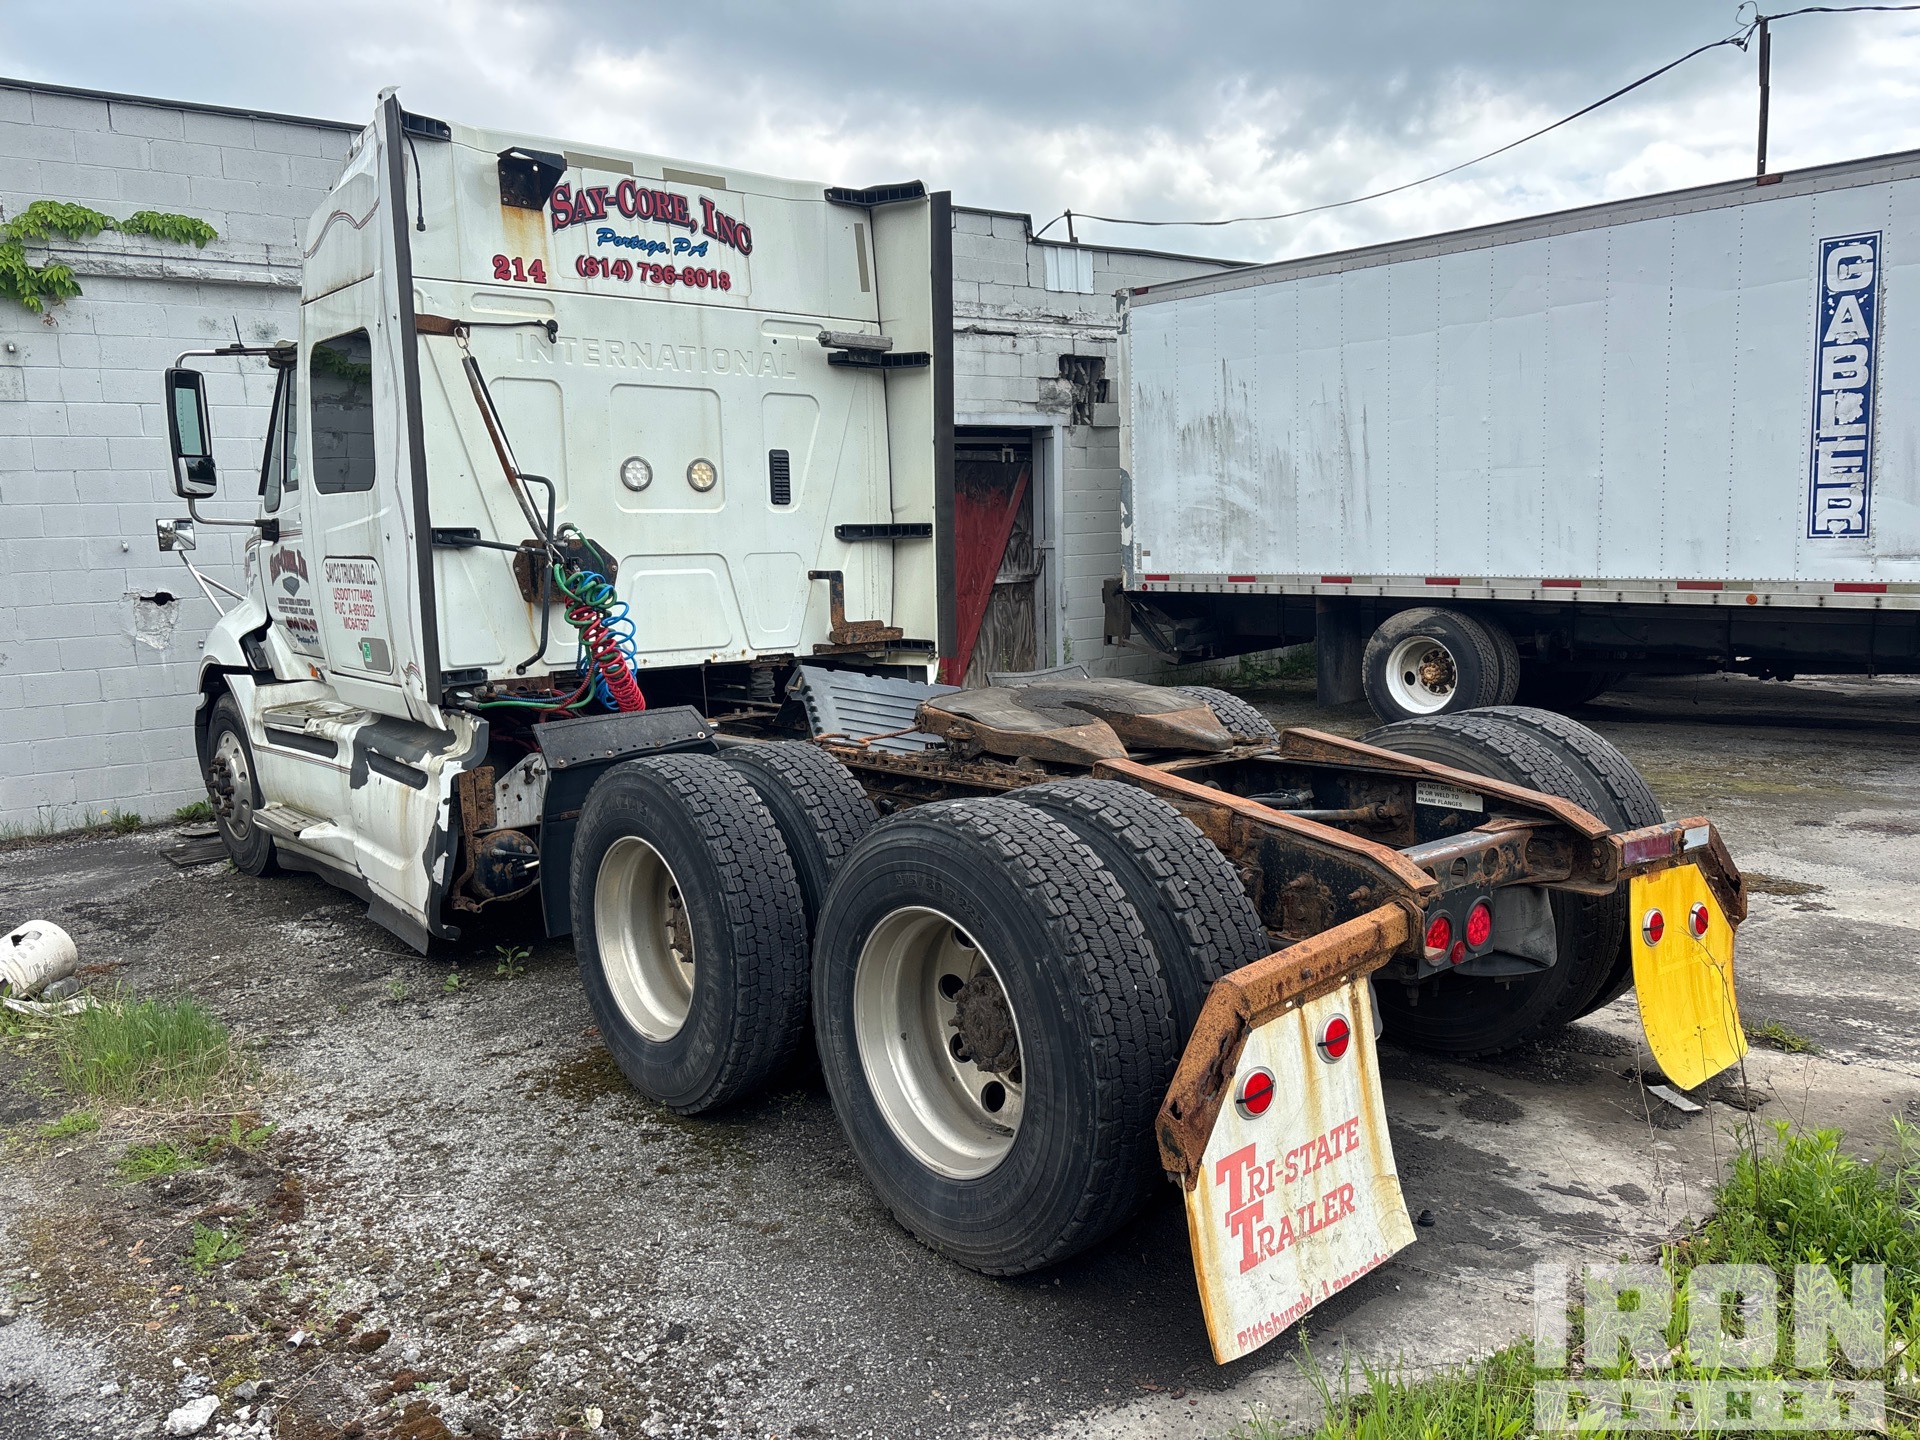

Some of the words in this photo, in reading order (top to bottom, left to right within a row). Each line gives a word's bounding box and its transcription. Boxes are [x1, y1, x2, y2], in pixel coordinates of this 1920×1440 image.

[596, 227, 670, 258] Portage,
[672, 236, 709, 257] PA
[492, 254, 547, 284] 214
[576, 255, 633, 281] (814)
[637, 261, 731, 291] 736-8018
[515, 332, 798, 380] INTERNATIONAL
[1437, 799, 1463, 807] FLANGES
[1229, 1182, 1356, 1275] TRAILER
